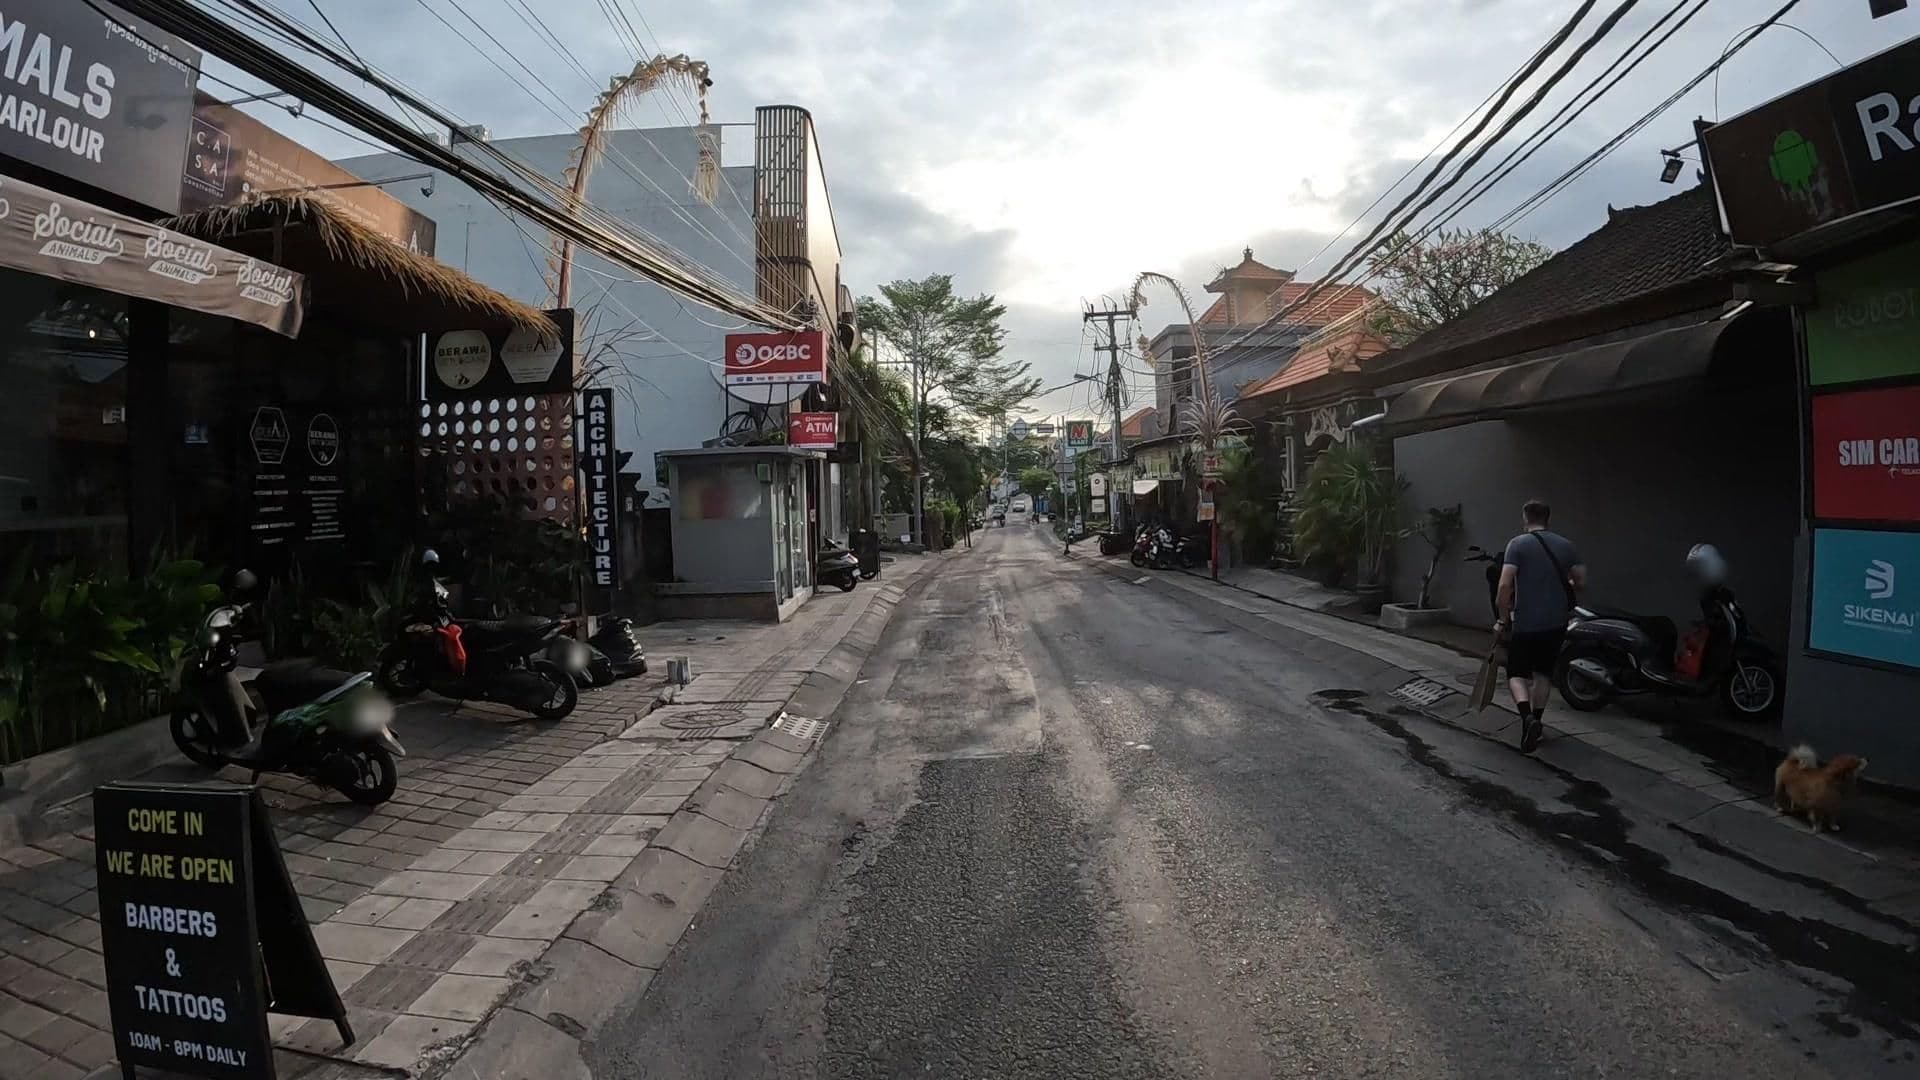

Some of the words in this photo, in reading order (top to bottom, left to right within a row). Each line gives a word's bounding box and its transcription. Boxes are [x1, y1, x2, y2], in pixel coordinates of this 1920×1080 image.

[0, 92, 105, 164] ARLOUR
[33, 203, 124, 249] Social
[48, 243, 99, 262] ANIMALS
[144, 230, 217, 273] Social
[156, 263, 198, 282] ANIMALS
[236, 257, 294, 296] Social
[438, 345, 487, 357] BERAWA
[757, 345, 811, 361] OCBC
[806, 422, 832, 433] ATM
[1838, 439, 1875, 466] SIM
[589, 394, 612, 585] ARCHITECTURE
[128, 808, 177, 835] COME
[184, 811, 204, 836] IN
[106, 850, 135, 875] WE
[140, 854, 176, 880] ARE
[181, 857, 234, 884] OPEN
[125, 902, 217, 937] BARBERS
[165, 948, 182, 977] &
[135, 985, 227, 1023] TATTOOS
[129, 1031, 162, 1052] 10AM
[173, 1039, 203, 1060] 8PM
[206, 1045, 248, 1067] DAILY
